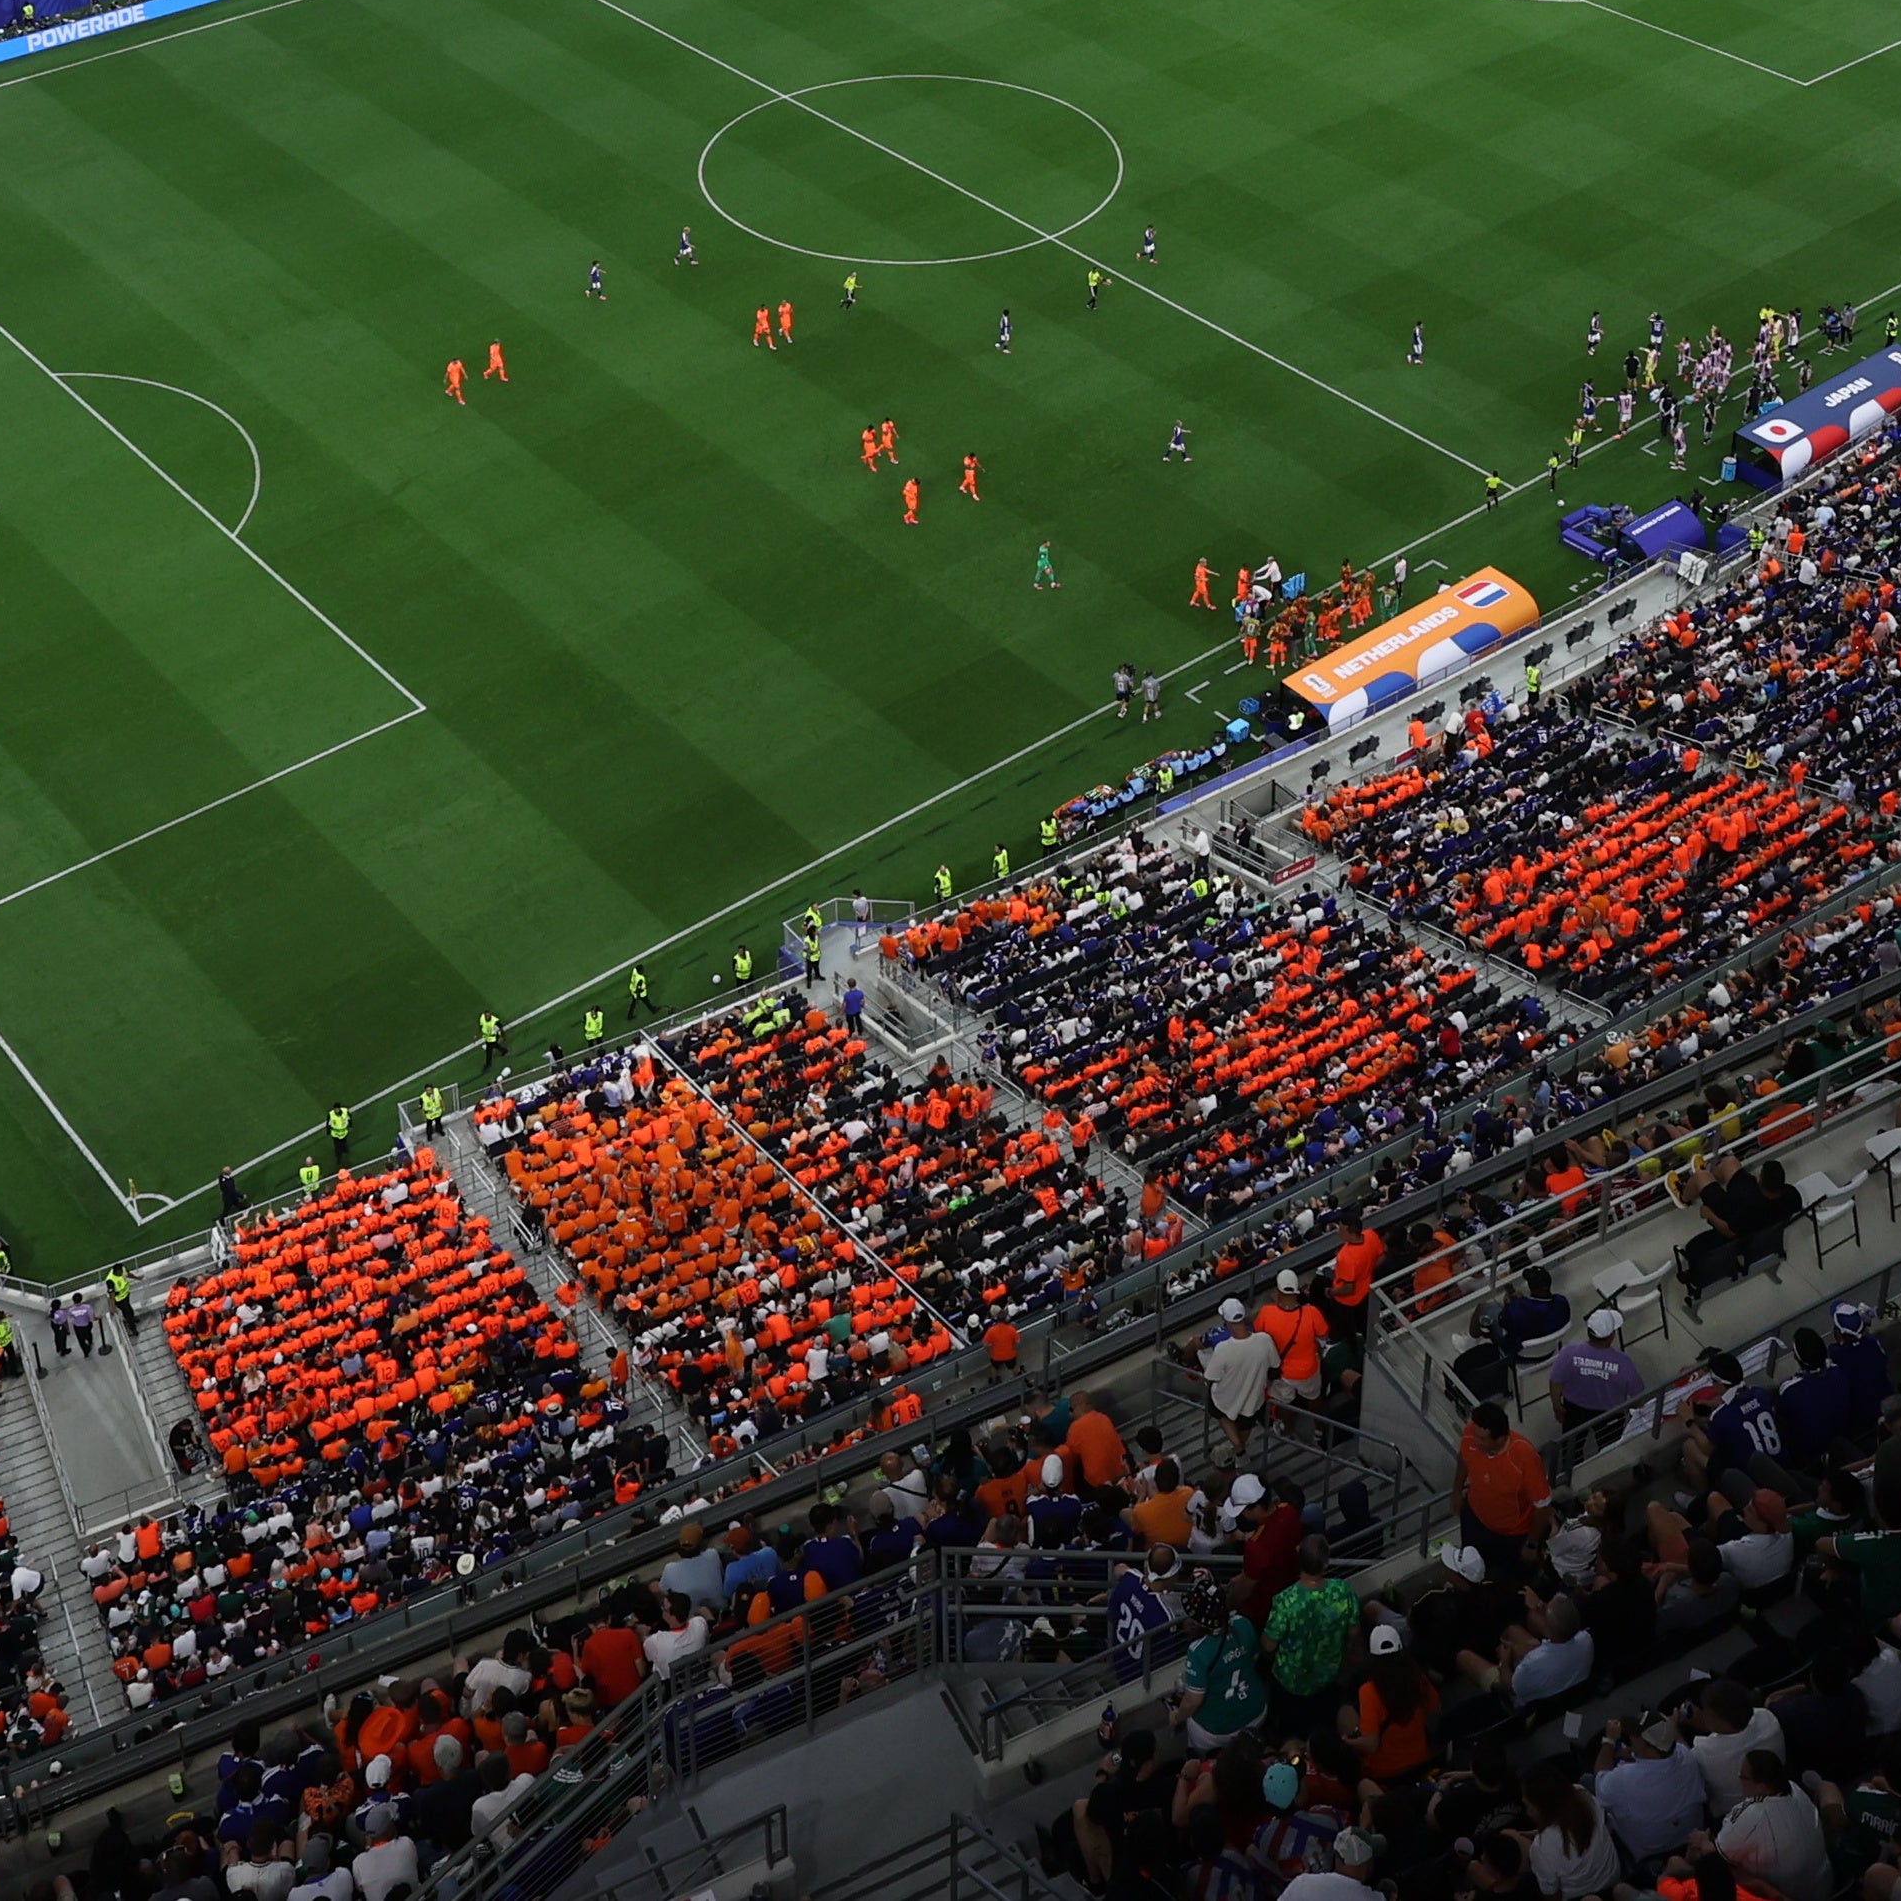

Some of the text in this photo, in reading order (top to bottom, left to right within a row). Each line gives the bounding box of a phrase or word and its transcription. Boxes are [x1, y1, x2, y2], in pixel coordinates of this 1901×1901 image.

[1824, 377, 1873, 409] JAPAN
[1333, 606, 1459, 680] NETHERLANDS
[1573, 1356, 1619, 1374] STADIUM FAN
[1580, 1367, 1609, 1380] SERVICES
[1742, 1410, 1781, 1456] 18
